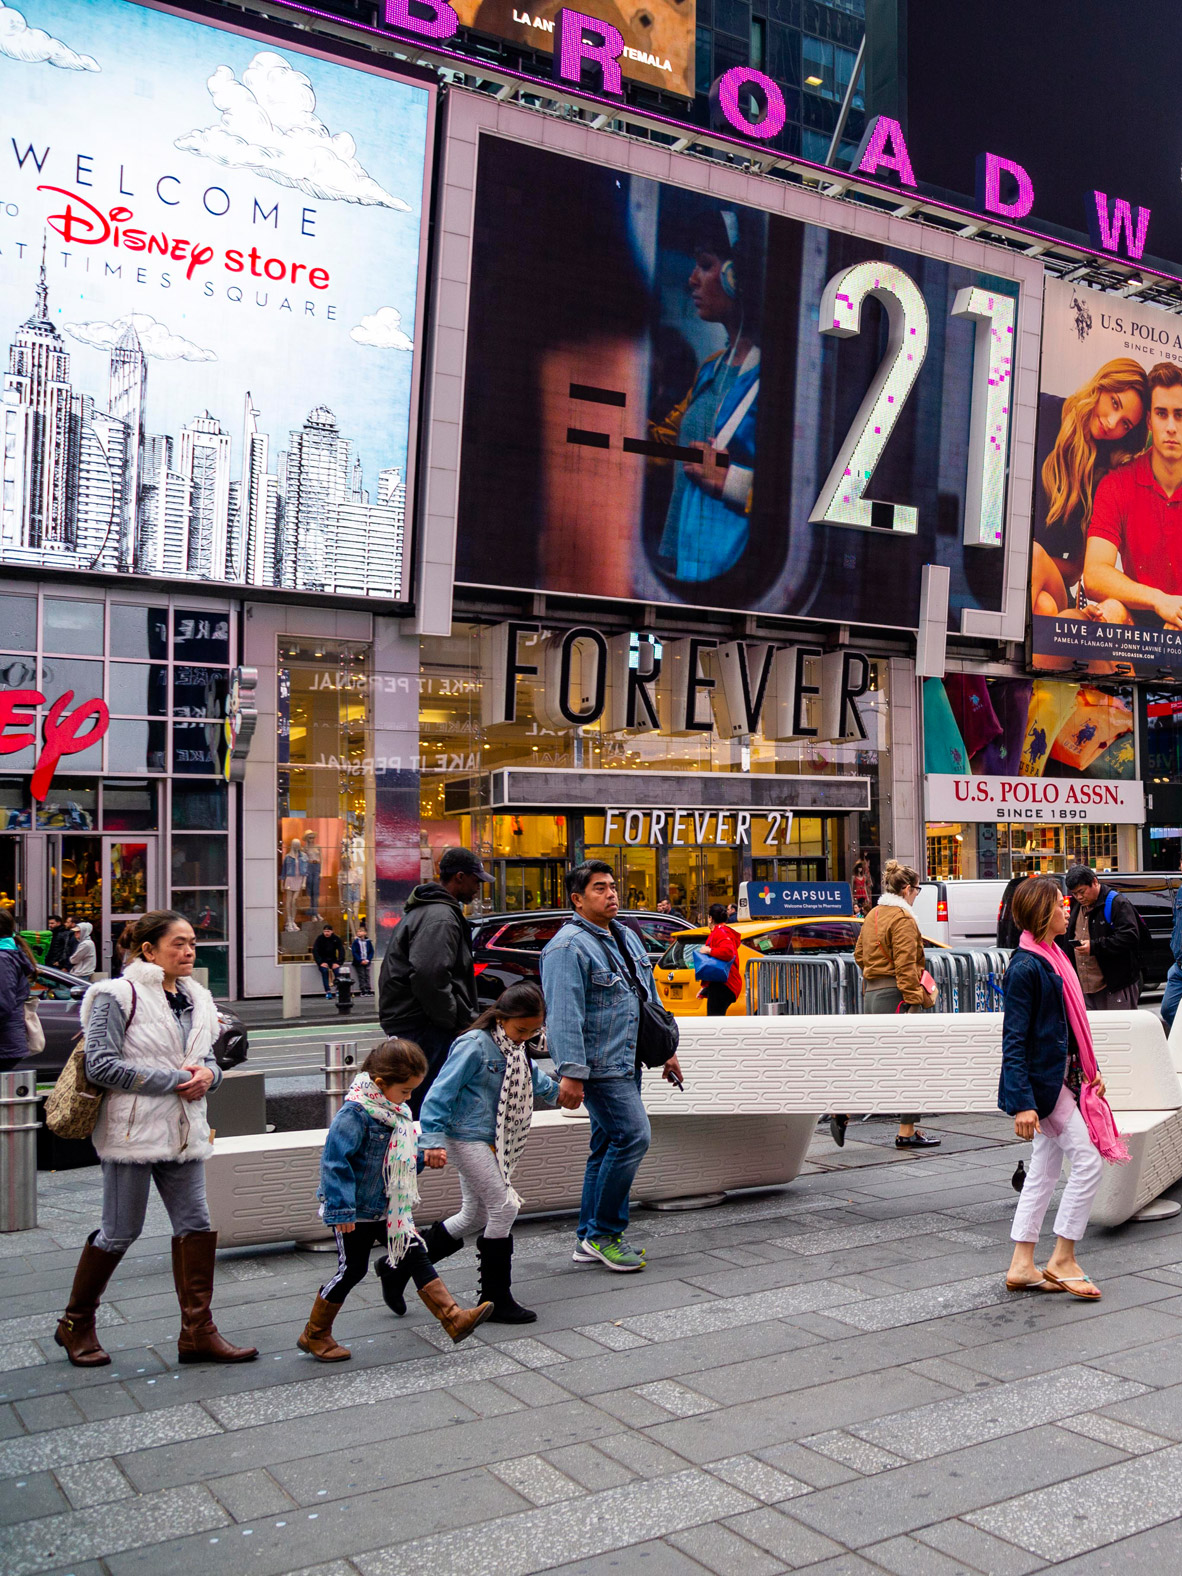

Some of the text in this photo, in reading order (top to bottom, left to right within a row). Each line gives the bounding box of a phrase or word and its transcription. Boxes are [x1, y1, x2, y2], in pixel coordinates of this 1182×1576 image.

[11, 137, 318, 237] WELCOME
[225, 246, 331, 290] store
[60, 251, 173, 289] TIMES
[203, 281, 338, 322] SQUARE
[1100, 312, 1127, 335] U.S.
[1130, 321, 1170, 346] POLO
[1123, 340, 1156, 356] SINCE
[1055, 622, 1088, 636] LIVE
[1054, 636, 1079, 645] PAMELA
[1080, 639, 1113, 649] FLANAGAN
[1120, 643, 1141, 651] JONNY
[1141, 645, 1163, 653] LAVINE
[1166, 647, 1182, 656] POLO
[500, 619, 870, 742] FOREVER
[953, 780, 1124, 806] U.S. POLO ASSN.
[604, 808, 794, 846] FOREVER 21
[996, 808, 1087, 819] SINCE 1890
[782, 890, 842, 901] CAPSULE
